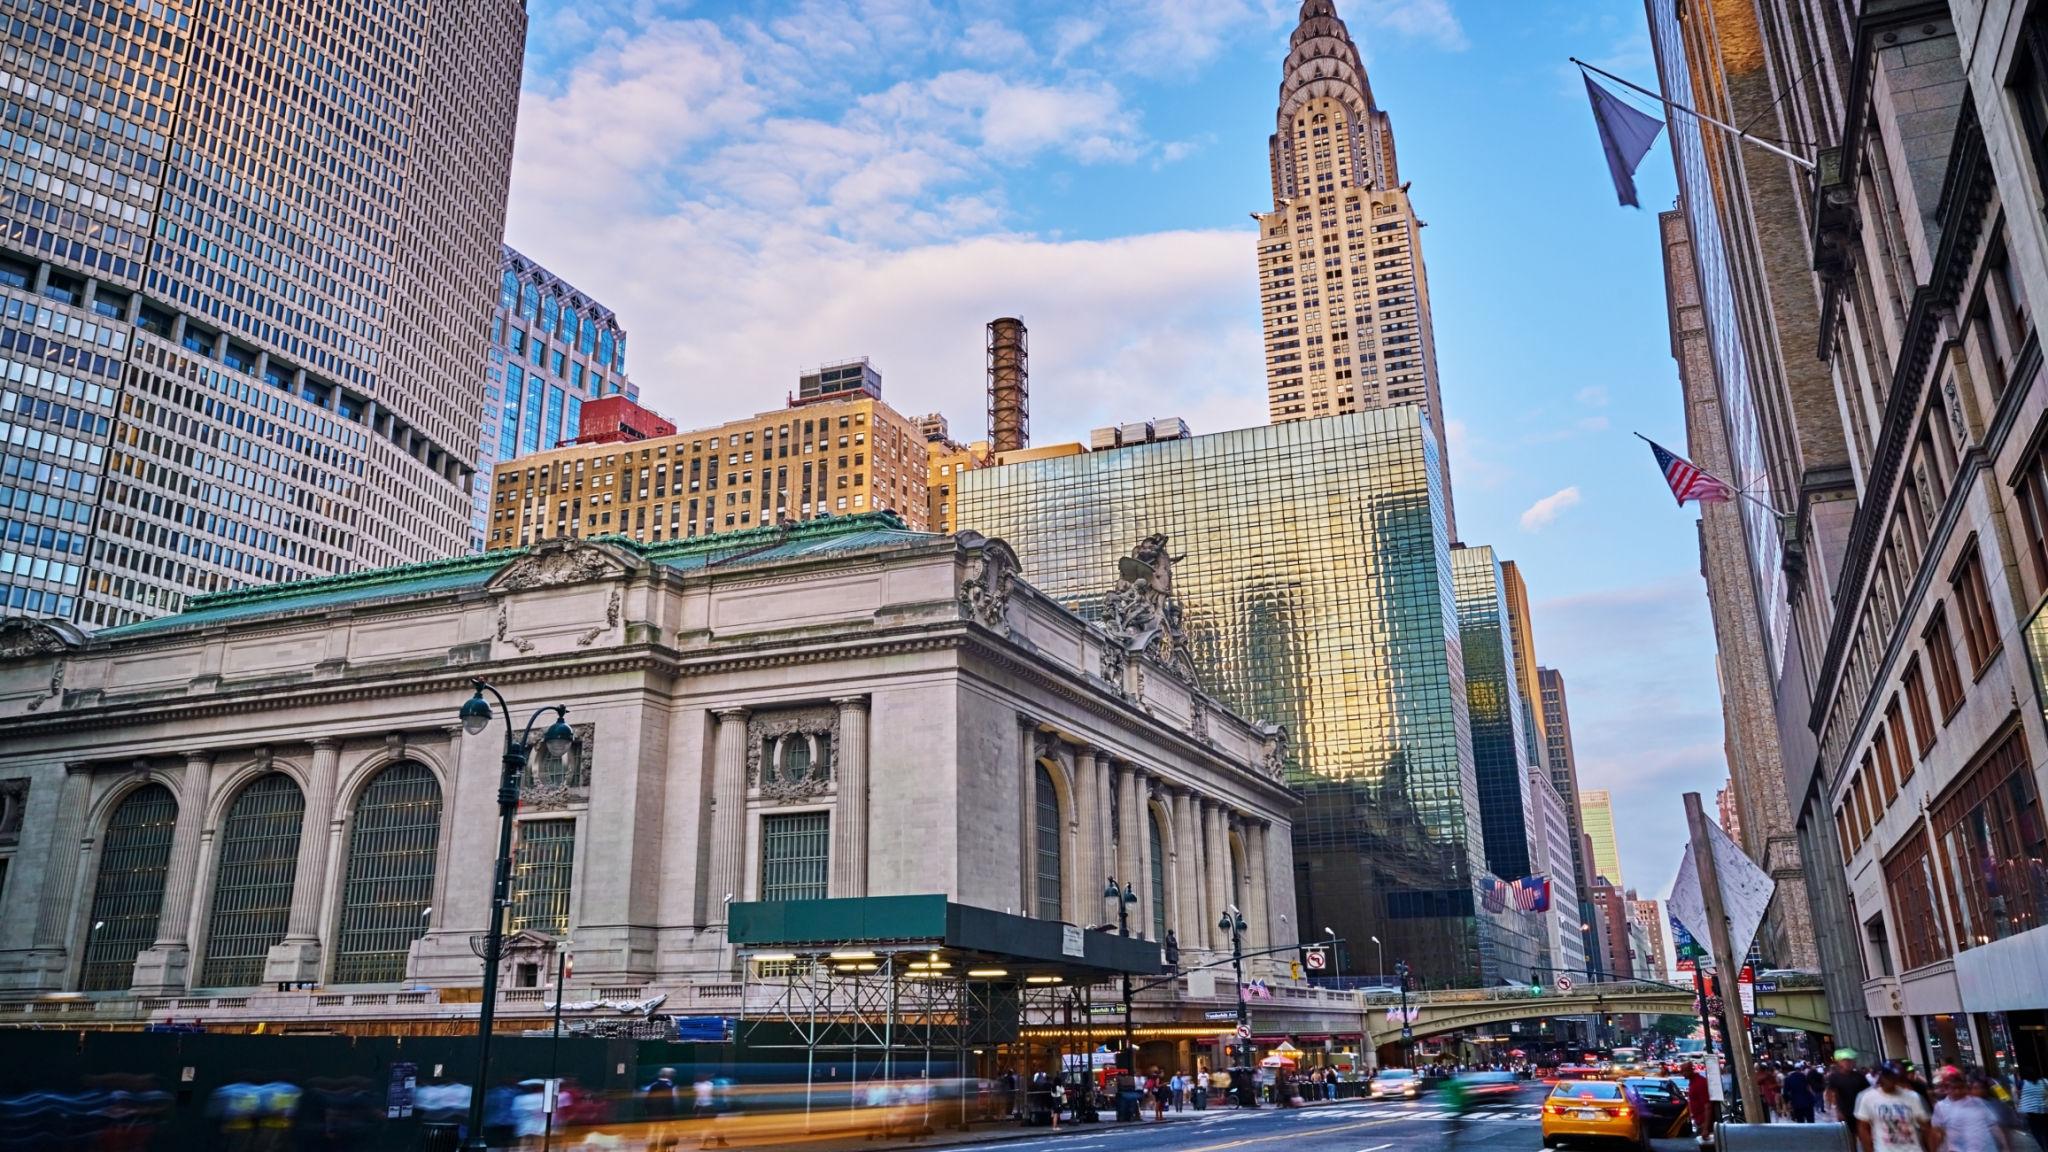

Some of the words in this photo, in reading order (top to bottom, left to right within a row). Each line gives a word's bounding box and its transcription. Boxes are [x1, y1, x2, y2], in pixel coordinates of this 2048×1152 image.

[1630, 1004, 1682, 1012] PERSHING
[1434, 1017, 1467, 1028] GRAND
[1472, 1010, 1517, 1020] CENTRAL
[1523, 1006, 1573, 1015] TERMINAL
